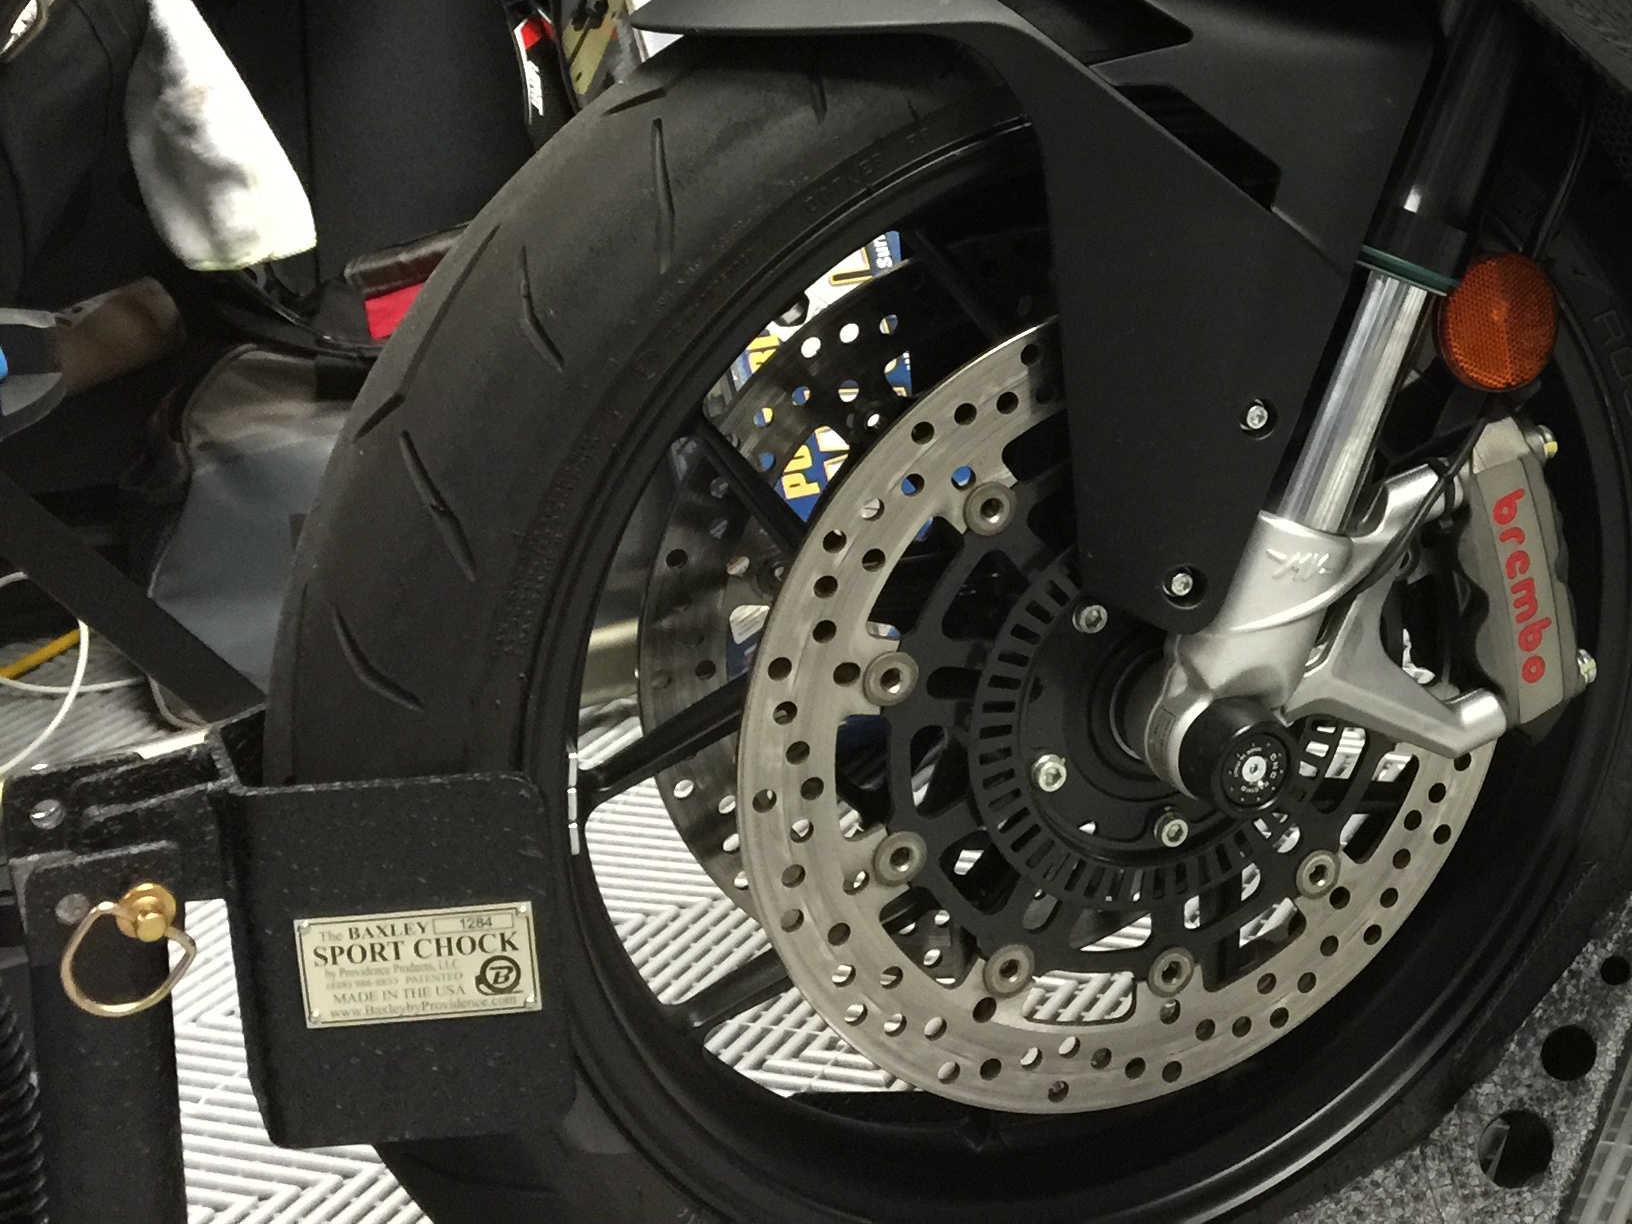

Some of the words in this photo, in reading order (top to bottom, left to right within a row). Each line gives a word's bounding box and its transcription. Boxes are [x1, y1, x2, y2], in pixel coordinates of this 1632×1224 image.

[1492, 487, 1552, 685] brembo
[320, 930, 343, 943] The
[348, 920, 430, 941] BAXLEY
[459, 916, 493, 930] 1284
[312, 940, 405, 968] SPORT
[413, 930, 520, 960] CHOCK
[339, 964, 391, 978] Providence
[405, 971, 463, 984] PATENTED
[332, 991, 380, 1005] MADE
[382, 990, 398, 1001] IN
[403, 987, 431, 1000] THE
[436, 985, 467, 997] USA
[329, 995, 518, 1019] www.BaxleybyProvidence.com
